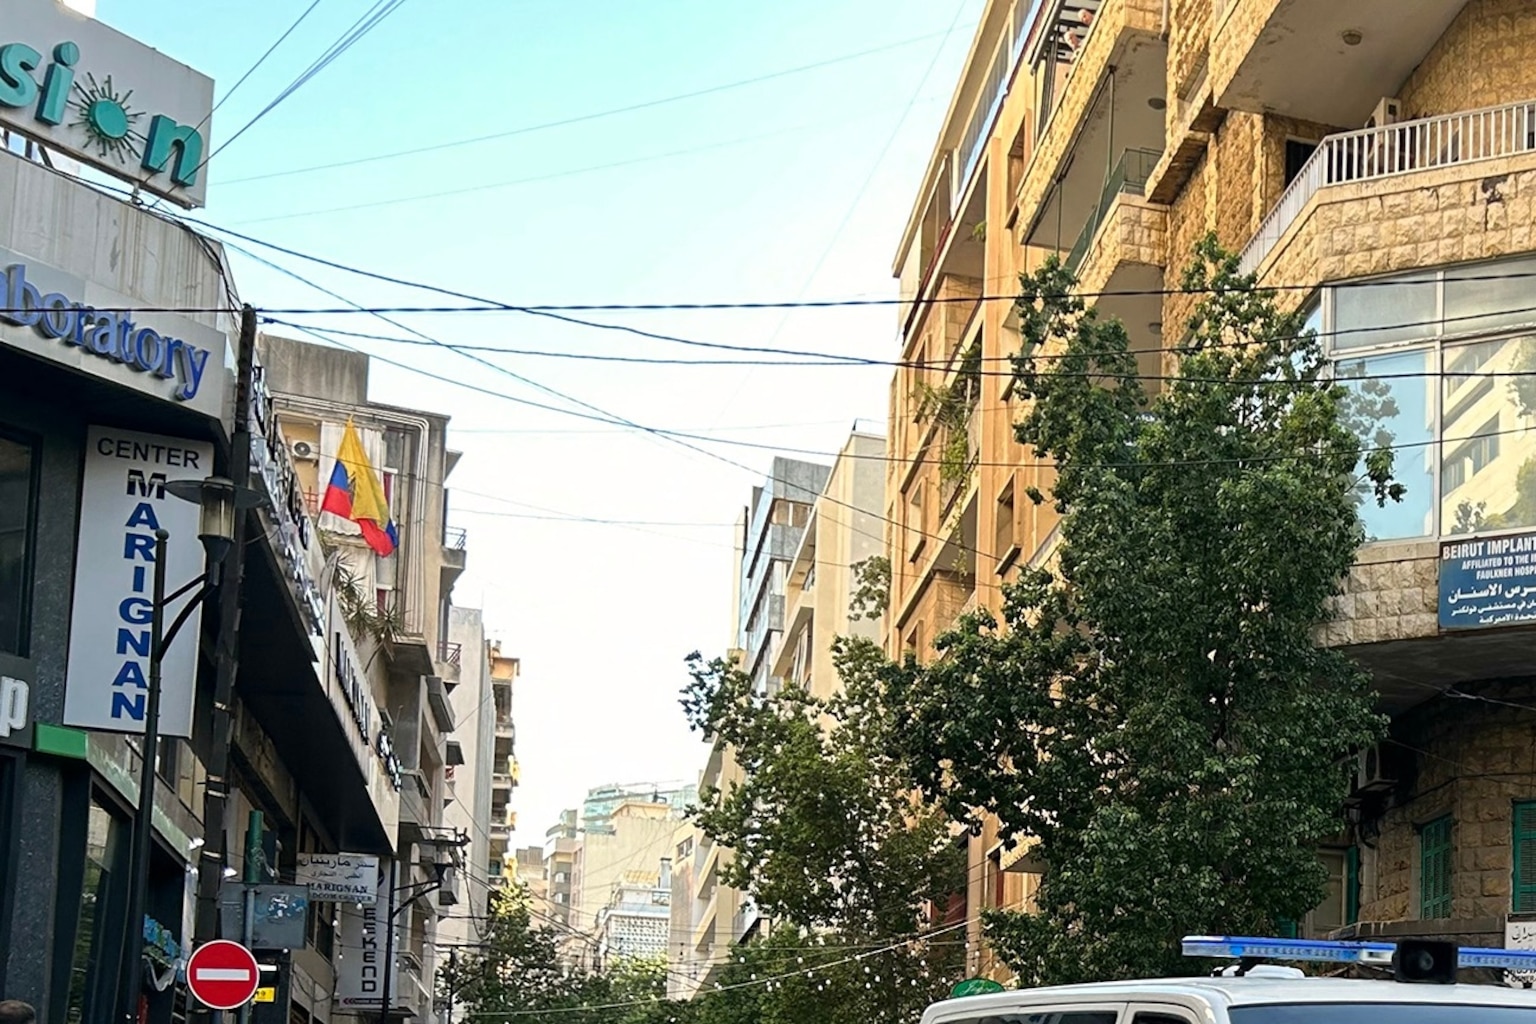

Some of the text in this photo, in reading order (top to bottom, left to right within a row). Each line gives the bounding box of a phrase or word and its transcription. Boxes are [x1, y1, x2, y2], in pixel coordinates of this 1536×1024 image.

[0, 264, 210, 400] boratory
[97, 436, 200, 470] CENTER
[1442, 542, 1484, 560] BEIRUT
[1461, 558, 1502, 570] AFFILIATED
[1504, 556, 1513, 566] TO
[1515, 554, 1529, 565] THE
[1476, 568, 1514, 580] FAULKNER
[110, 469, 167, 721] MARIGNAN
[1448, 583, 1502, 604] الاسنان
